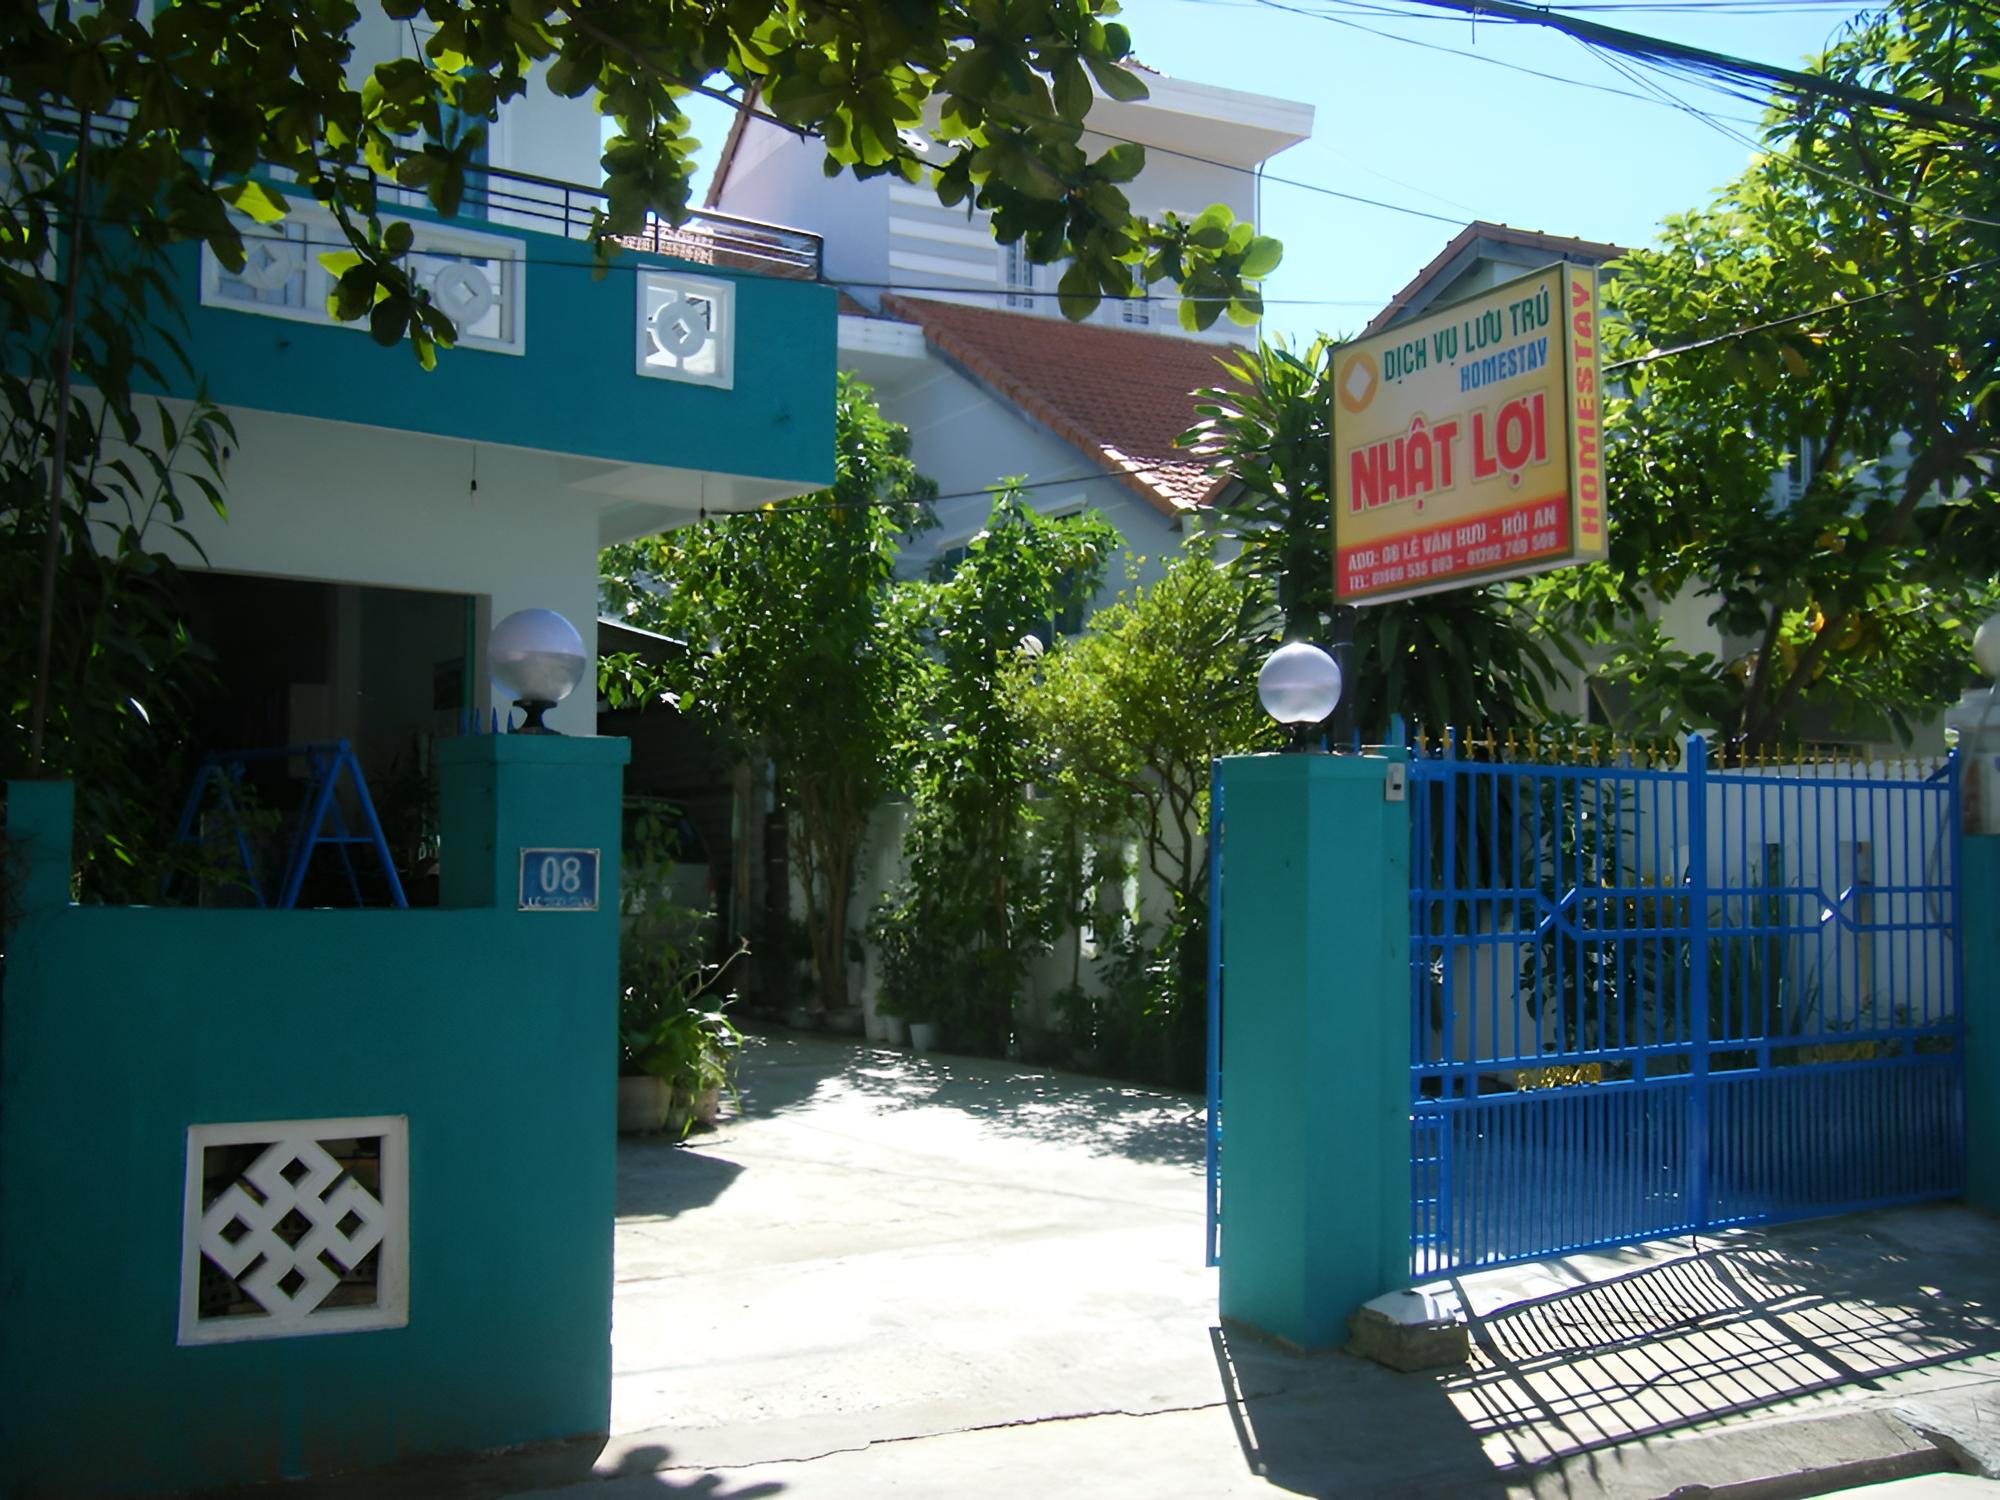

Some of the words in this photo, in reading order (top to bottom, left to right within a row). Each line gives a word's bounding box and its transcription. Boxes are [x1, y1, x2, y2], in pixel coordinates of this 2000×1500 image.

[1384, 338, 1427, 385] DỊCH
[1433, 326, 1458, 366] VỤ
[1464, 310, 1503, 354] LƯU
[1509, 285, 1549, 336] TRÚ
[1460, 336, 1548, 392] HOMESTAY
[1571, 281, 1600, 535] HOMESTAY
[1350, 416, 1459, 512] NHẬT
[1472, 393, 1547, 486] LỢI
[1502, 511, 1528, 539] HỘI
[1533, 505, 1556, 529] AN
[541, 856, 581, 893] 08
